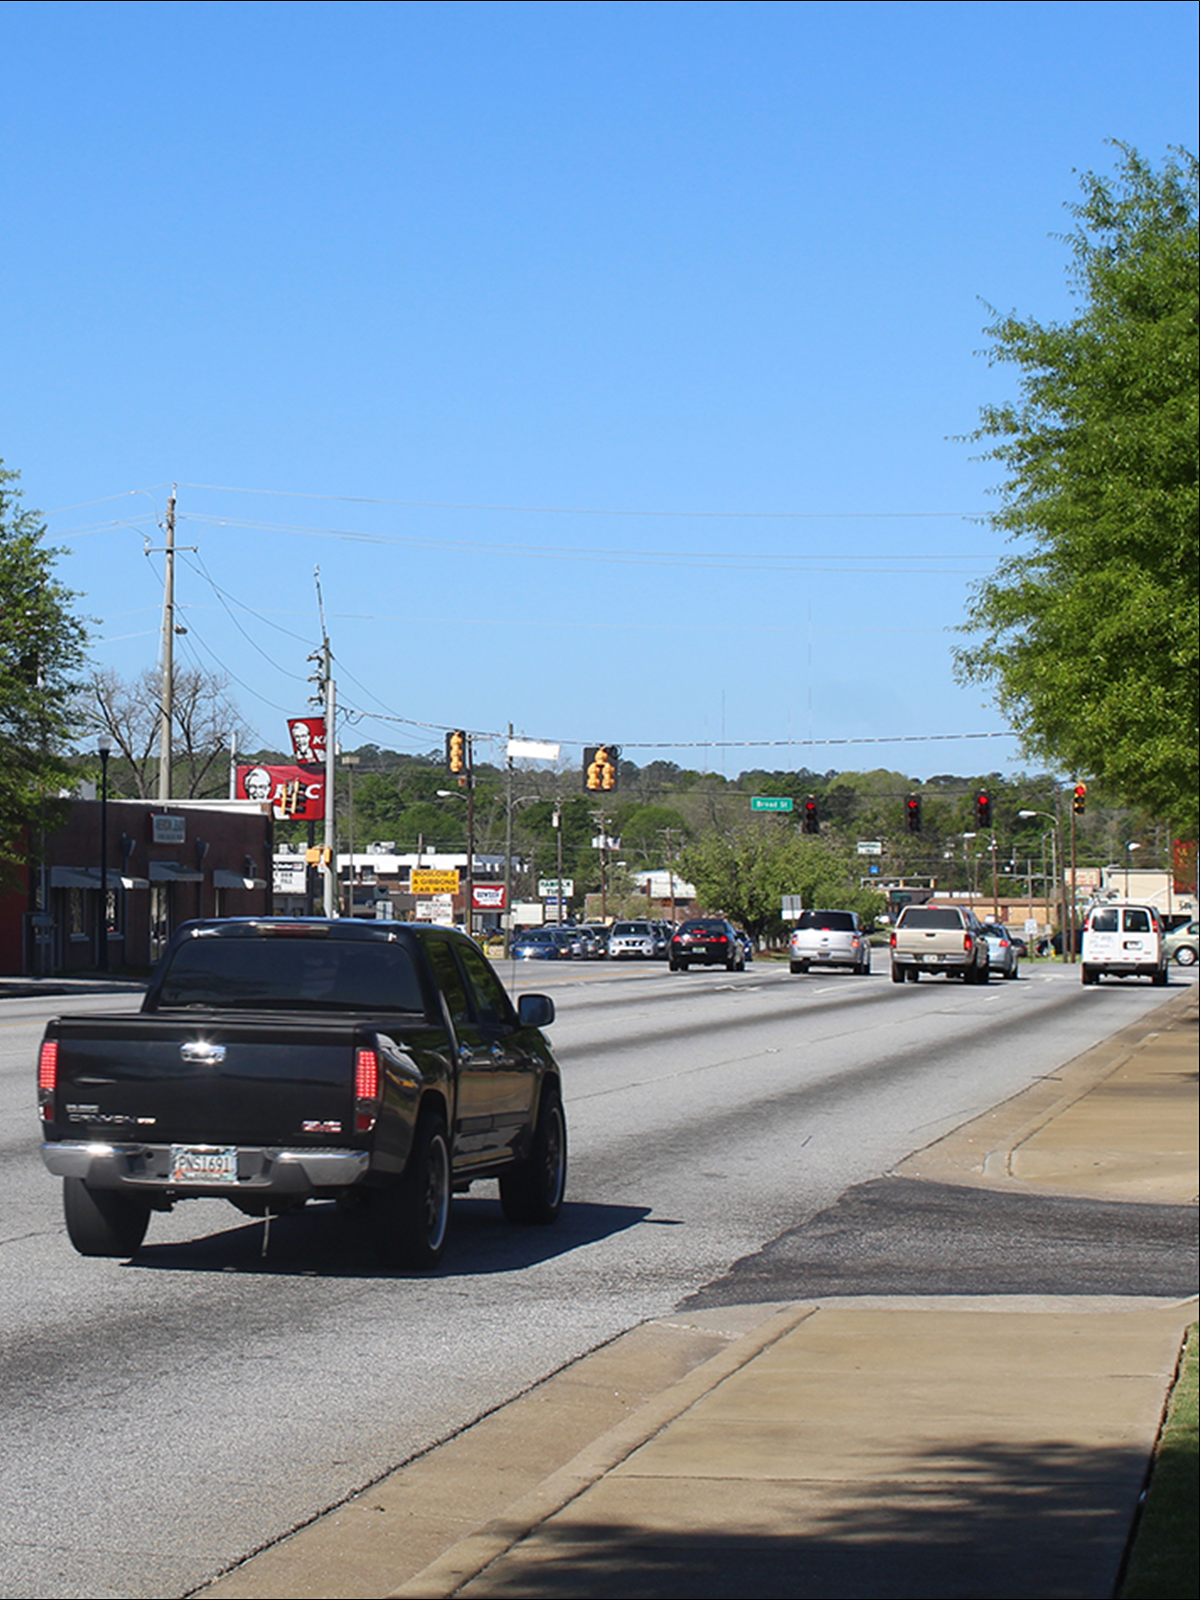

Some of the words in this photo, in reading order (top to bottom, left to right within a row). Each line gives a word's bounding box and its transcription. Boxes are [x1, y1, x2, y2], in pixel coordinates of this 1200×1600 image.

[273, 783, 323, 799] KC
[756, 800, 778, 808] Broad
[69, 1113, 136, 1124] CANYON
[302, 1120, 342, 1132] GMC
[179, 1155, 230, 1171] PNS1691
